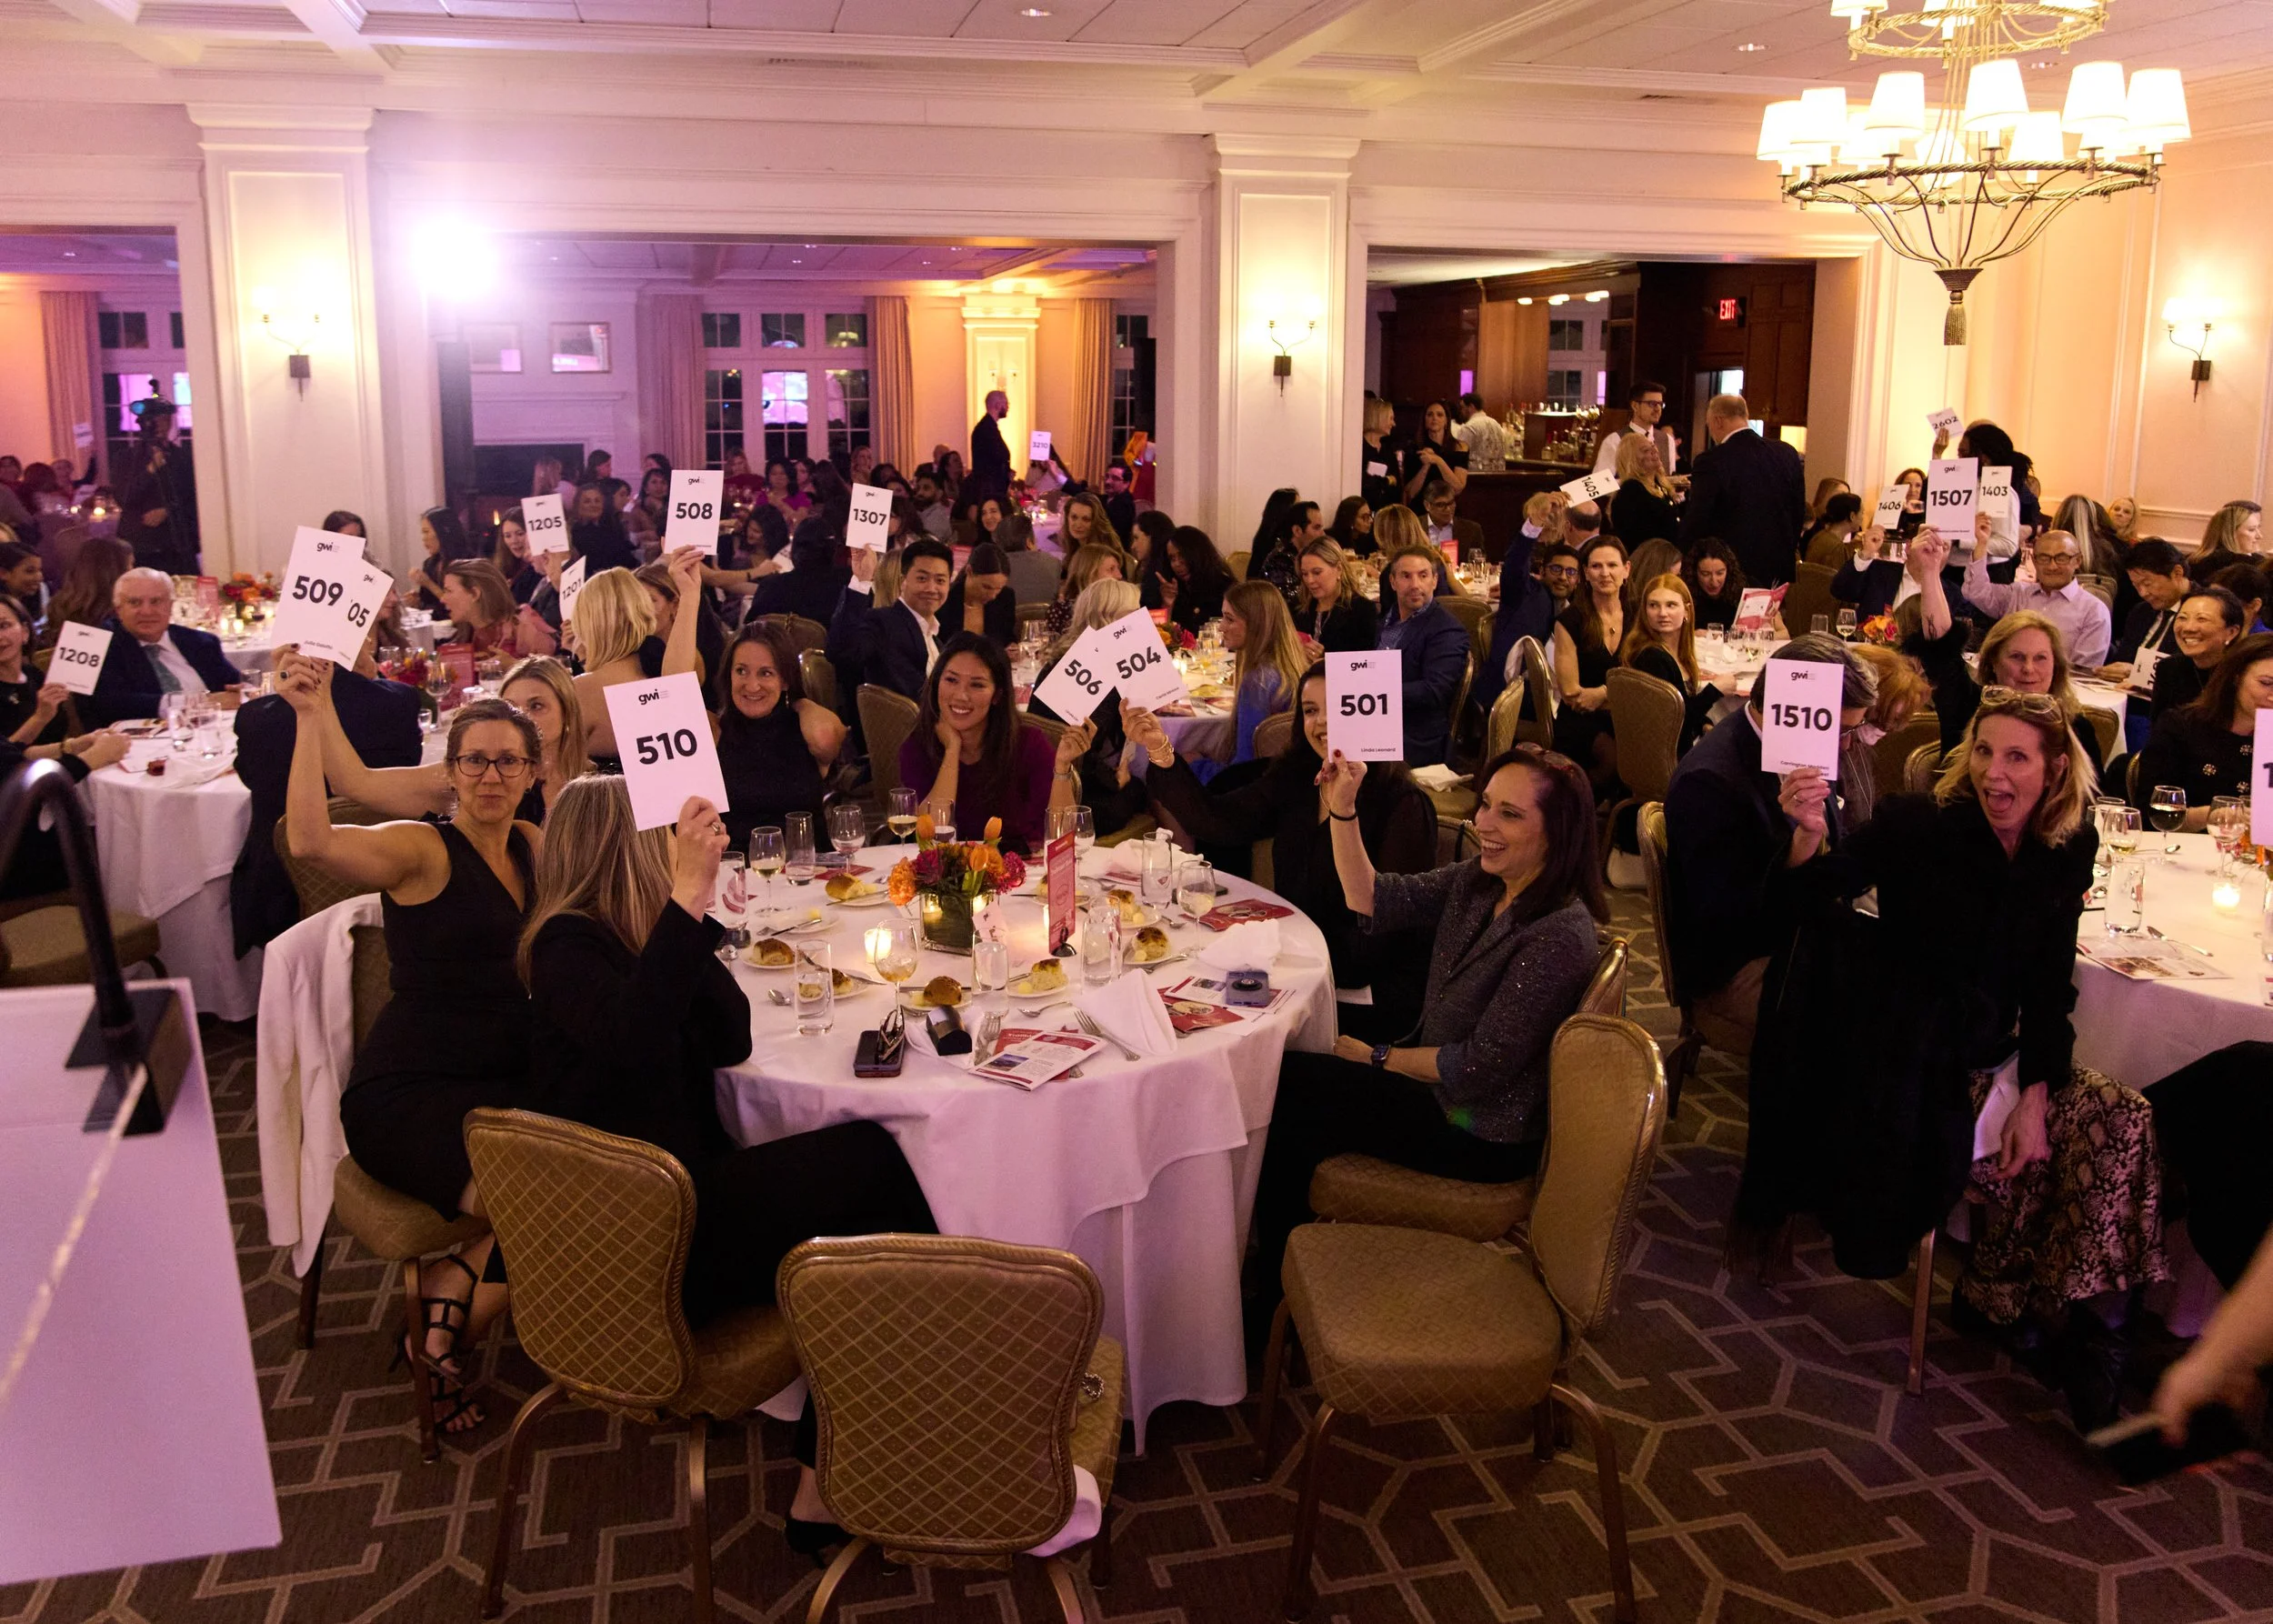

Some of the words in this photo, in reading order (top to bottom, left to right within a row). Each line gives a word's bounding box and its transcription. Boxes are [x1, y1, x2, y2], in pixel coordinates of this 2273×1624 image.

[1720, 299, 1736, 319] EXIT
[1933, 416, 1958, 429] 2602
[1944, 465, 1956, 474] gwi
[688, 476, 700, 485] gwi
[1582, 476, 1599, 497] 1405
[1930, 489, 1972, 506] 1507
[1982, 486, 2008, 496] 1403
[676, 502, 713, 519] 508
[1878, 501, 1901, 511] 1406
[528, 516, 562, 531] 1205
[854, 508, 886, 526] 1307
[316, 542, 334, 552] gwi
[292, 575, 344, 606] 509
[562, 578, 582, 601] 1201
[347, 599, 370, 627] 05
[1113, 625, 1127, 639] gwi
[59, 647, 100, 667] 1208
[1116, 646, 1161, 679] 504
[1350, 659, 1367, 671] gwi
[1064, 658, 1103, 696] 506
[1790, 670, 1808, 681] gwi
[638, 688, 660, 706] gwi
[1340, 693, 1387, 717] 501
[1771, 703, 1832, 731] 1510
[636, 728, 697, 765] 510
